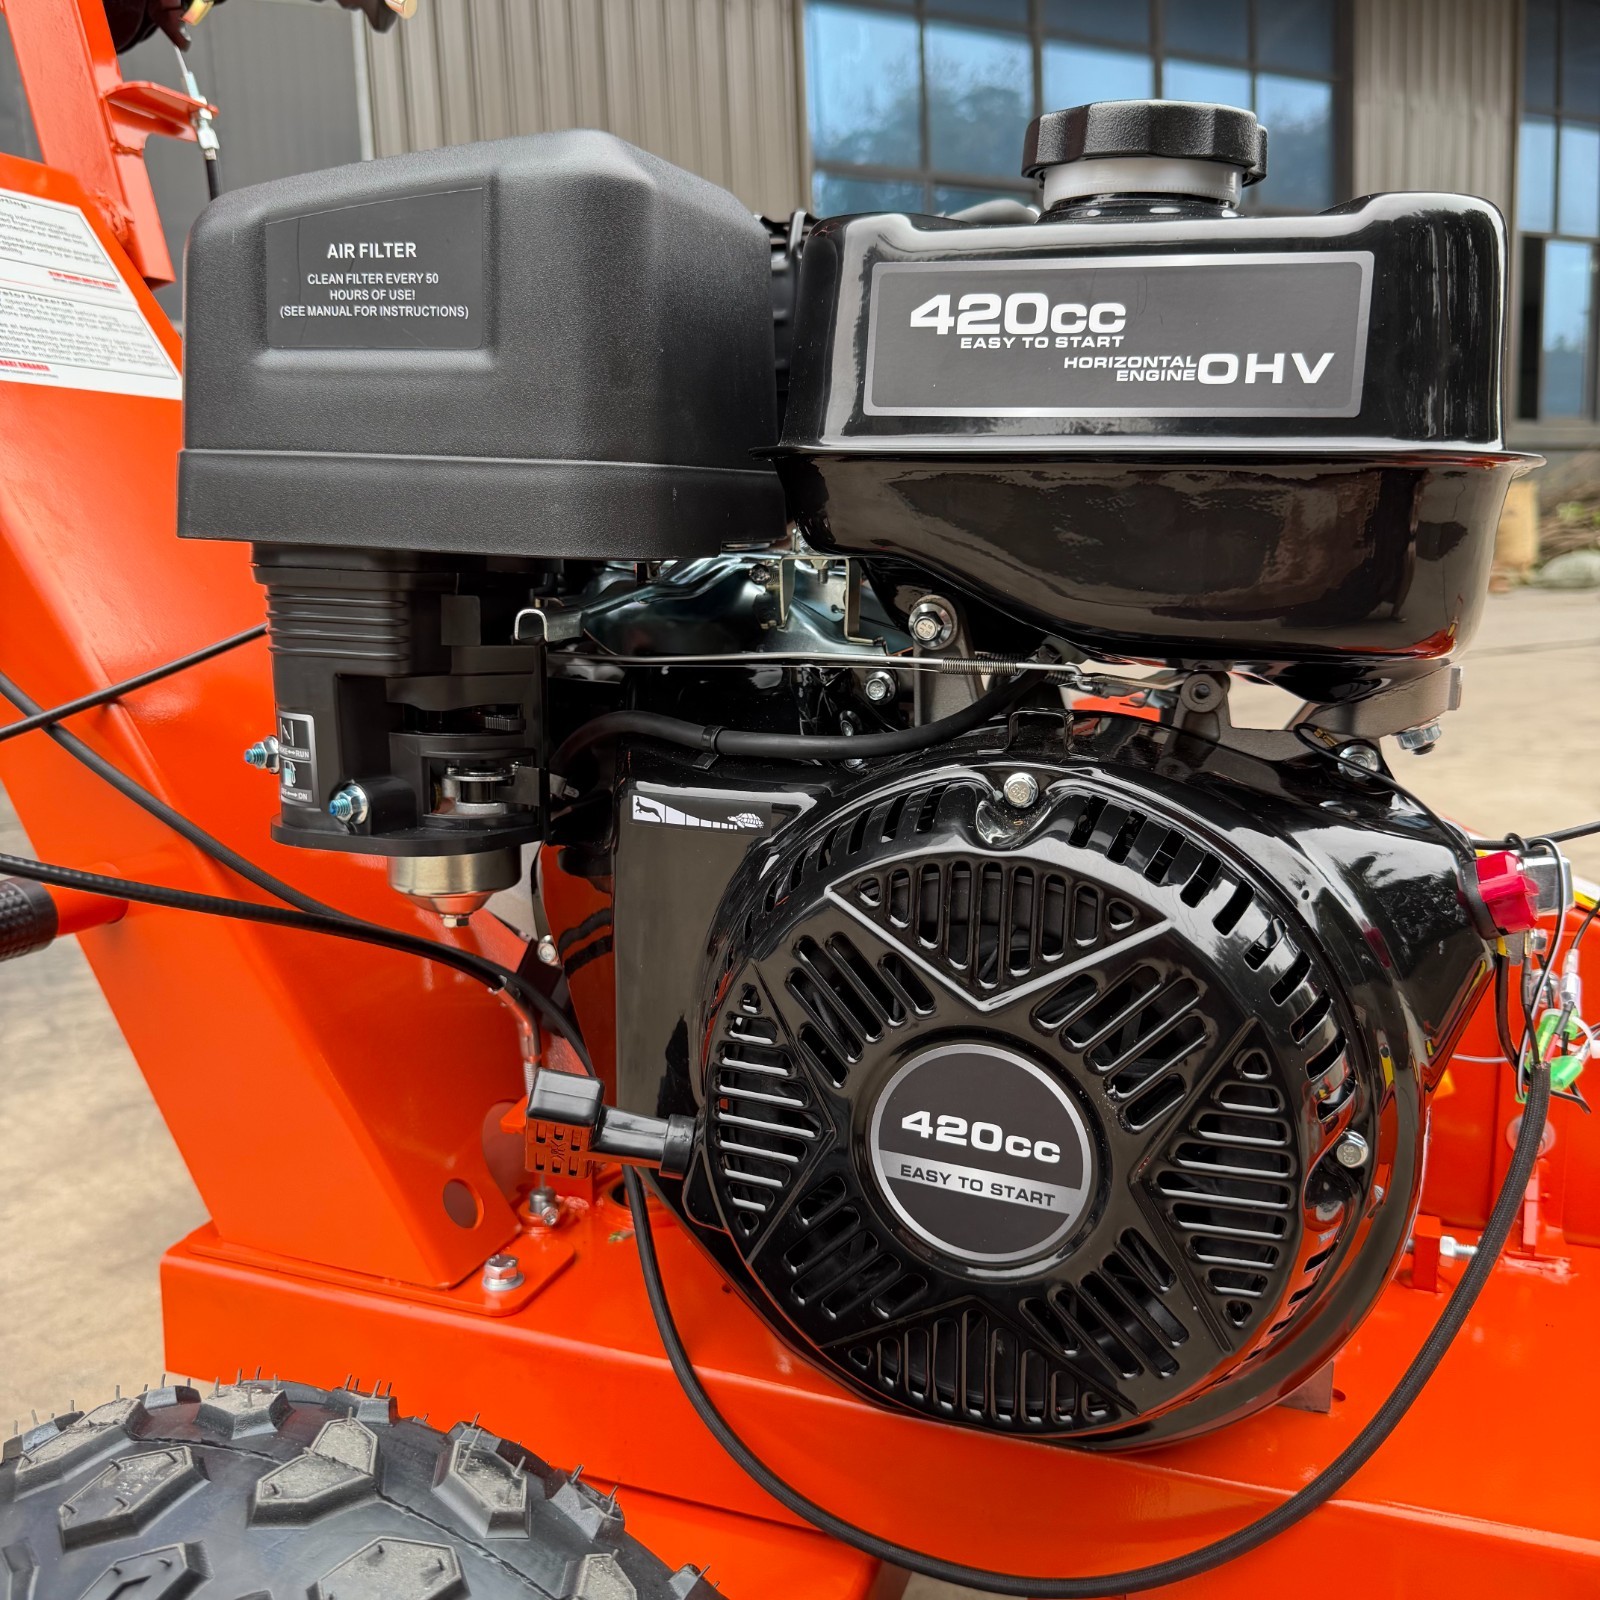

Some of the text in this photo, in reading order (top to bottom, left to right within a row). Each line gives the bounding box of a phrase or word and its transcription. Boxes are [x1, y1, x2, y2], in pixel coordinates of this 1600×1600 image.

[326, 242, 417, 259] AIR FILTER
[307, 272, 439, 285] CLEAN FILTER EVERY 50
[329, 289, 416, 301] HOURS OF USE!
[279, 305, 469, 319] (SEE MANUAL FOR INSTRUCTIONS)
[909, 292, 1127, 335] 420cc
[960, 335, 1125, 350] EASY TO START
[1063, 355, 1197, 369] HORIZONTAL
[1197, 352, 1335, 385] OHV
[1116, 369, 1196, 382] ENGINE
[296, 750, 309, 758] RUN
[298, 792, 308, 800] ON
[901, 1110, 1061, 1164] 420cc
[900, 1164, 1056, 1207] EASY TO START
